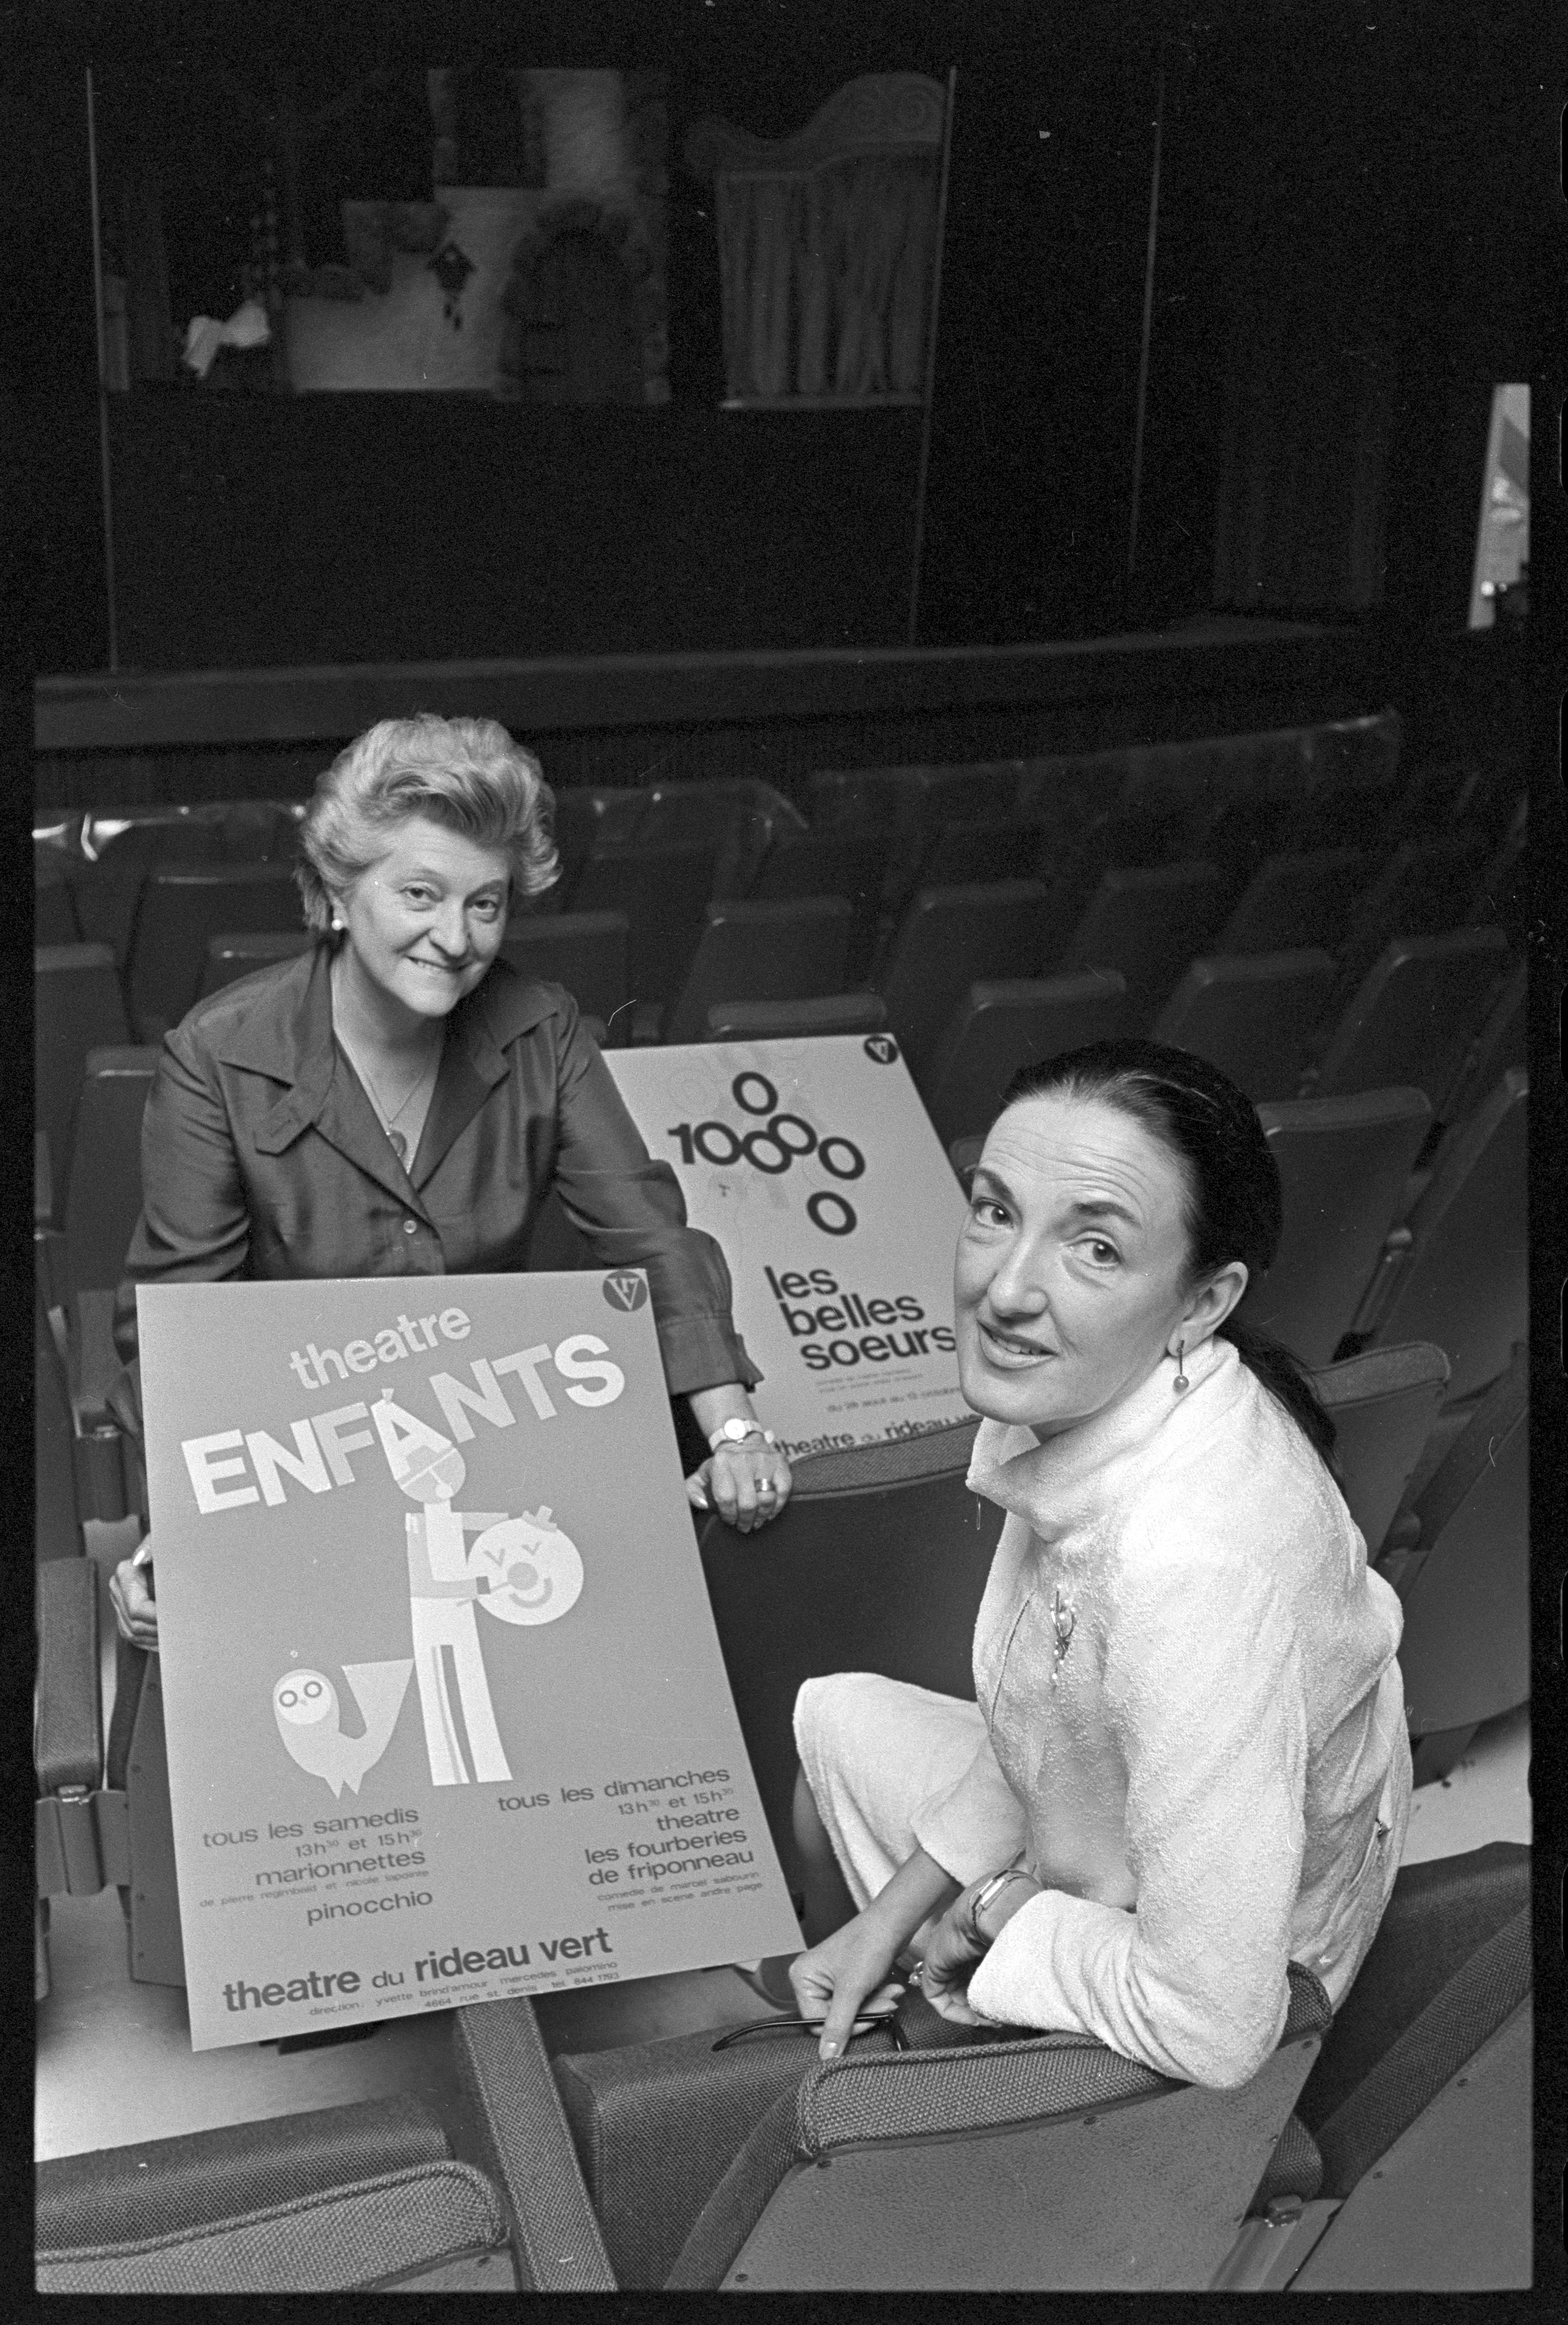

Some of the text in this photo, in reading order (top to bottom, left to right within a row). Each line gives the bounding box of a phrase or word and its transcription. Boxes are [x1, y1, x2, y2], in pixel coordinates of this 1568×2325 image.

[765, 1265, 839, 1300] les
[780, 1294, 924, 1336] belles
[289, 1307, 470, 1390] theatre
[800, 1326, 957, 1371] soeurs
[181, 1333, 625, 1515] ENFANTS
[774, 1434, 854, 1455] theatre
[498, 1769, 730, 1811] tous les dimanches
[668, 1796, 686, 1809] et
[203, 1808, 419, 1847] tous les samedis
[657, 1808, 739, 1831] theatre
[348, 1838, 366, 1851] et
[584, 1829, 747, 1864] les fourberies
[255, 1851, 426, 1886] marionnettes
[589, 1851, 754, 1885] de friponneau
[199, 1898, 214, 1907] de
[221, 1894, 253, 1906] pierre
[325, 1882, 337, 1890] et
[346, 1876, 379, 1887] nicole
[597, 1872, 759, 1901] comedie de marcel sabourin
[608, 1881, 763, 1911] mise en scene andre page
[307, 1891, 433, 1926] pinocchio
[223, 1927, 613, 2011] theatre du rideau vert
[376, 1993, 413, 2007] yvette
[420, 1980, 487, 1997] brind'amour
[500, 1970, 557, 1984] mercedes
[565, 1961, 618, 1976] palomino
[425, 1998, 452, 2008] 4664
[460, 1993, 479, 2002] rue
[507, 1984, 537, 1995] denis
[574, 1976, 593, 1985] 844
